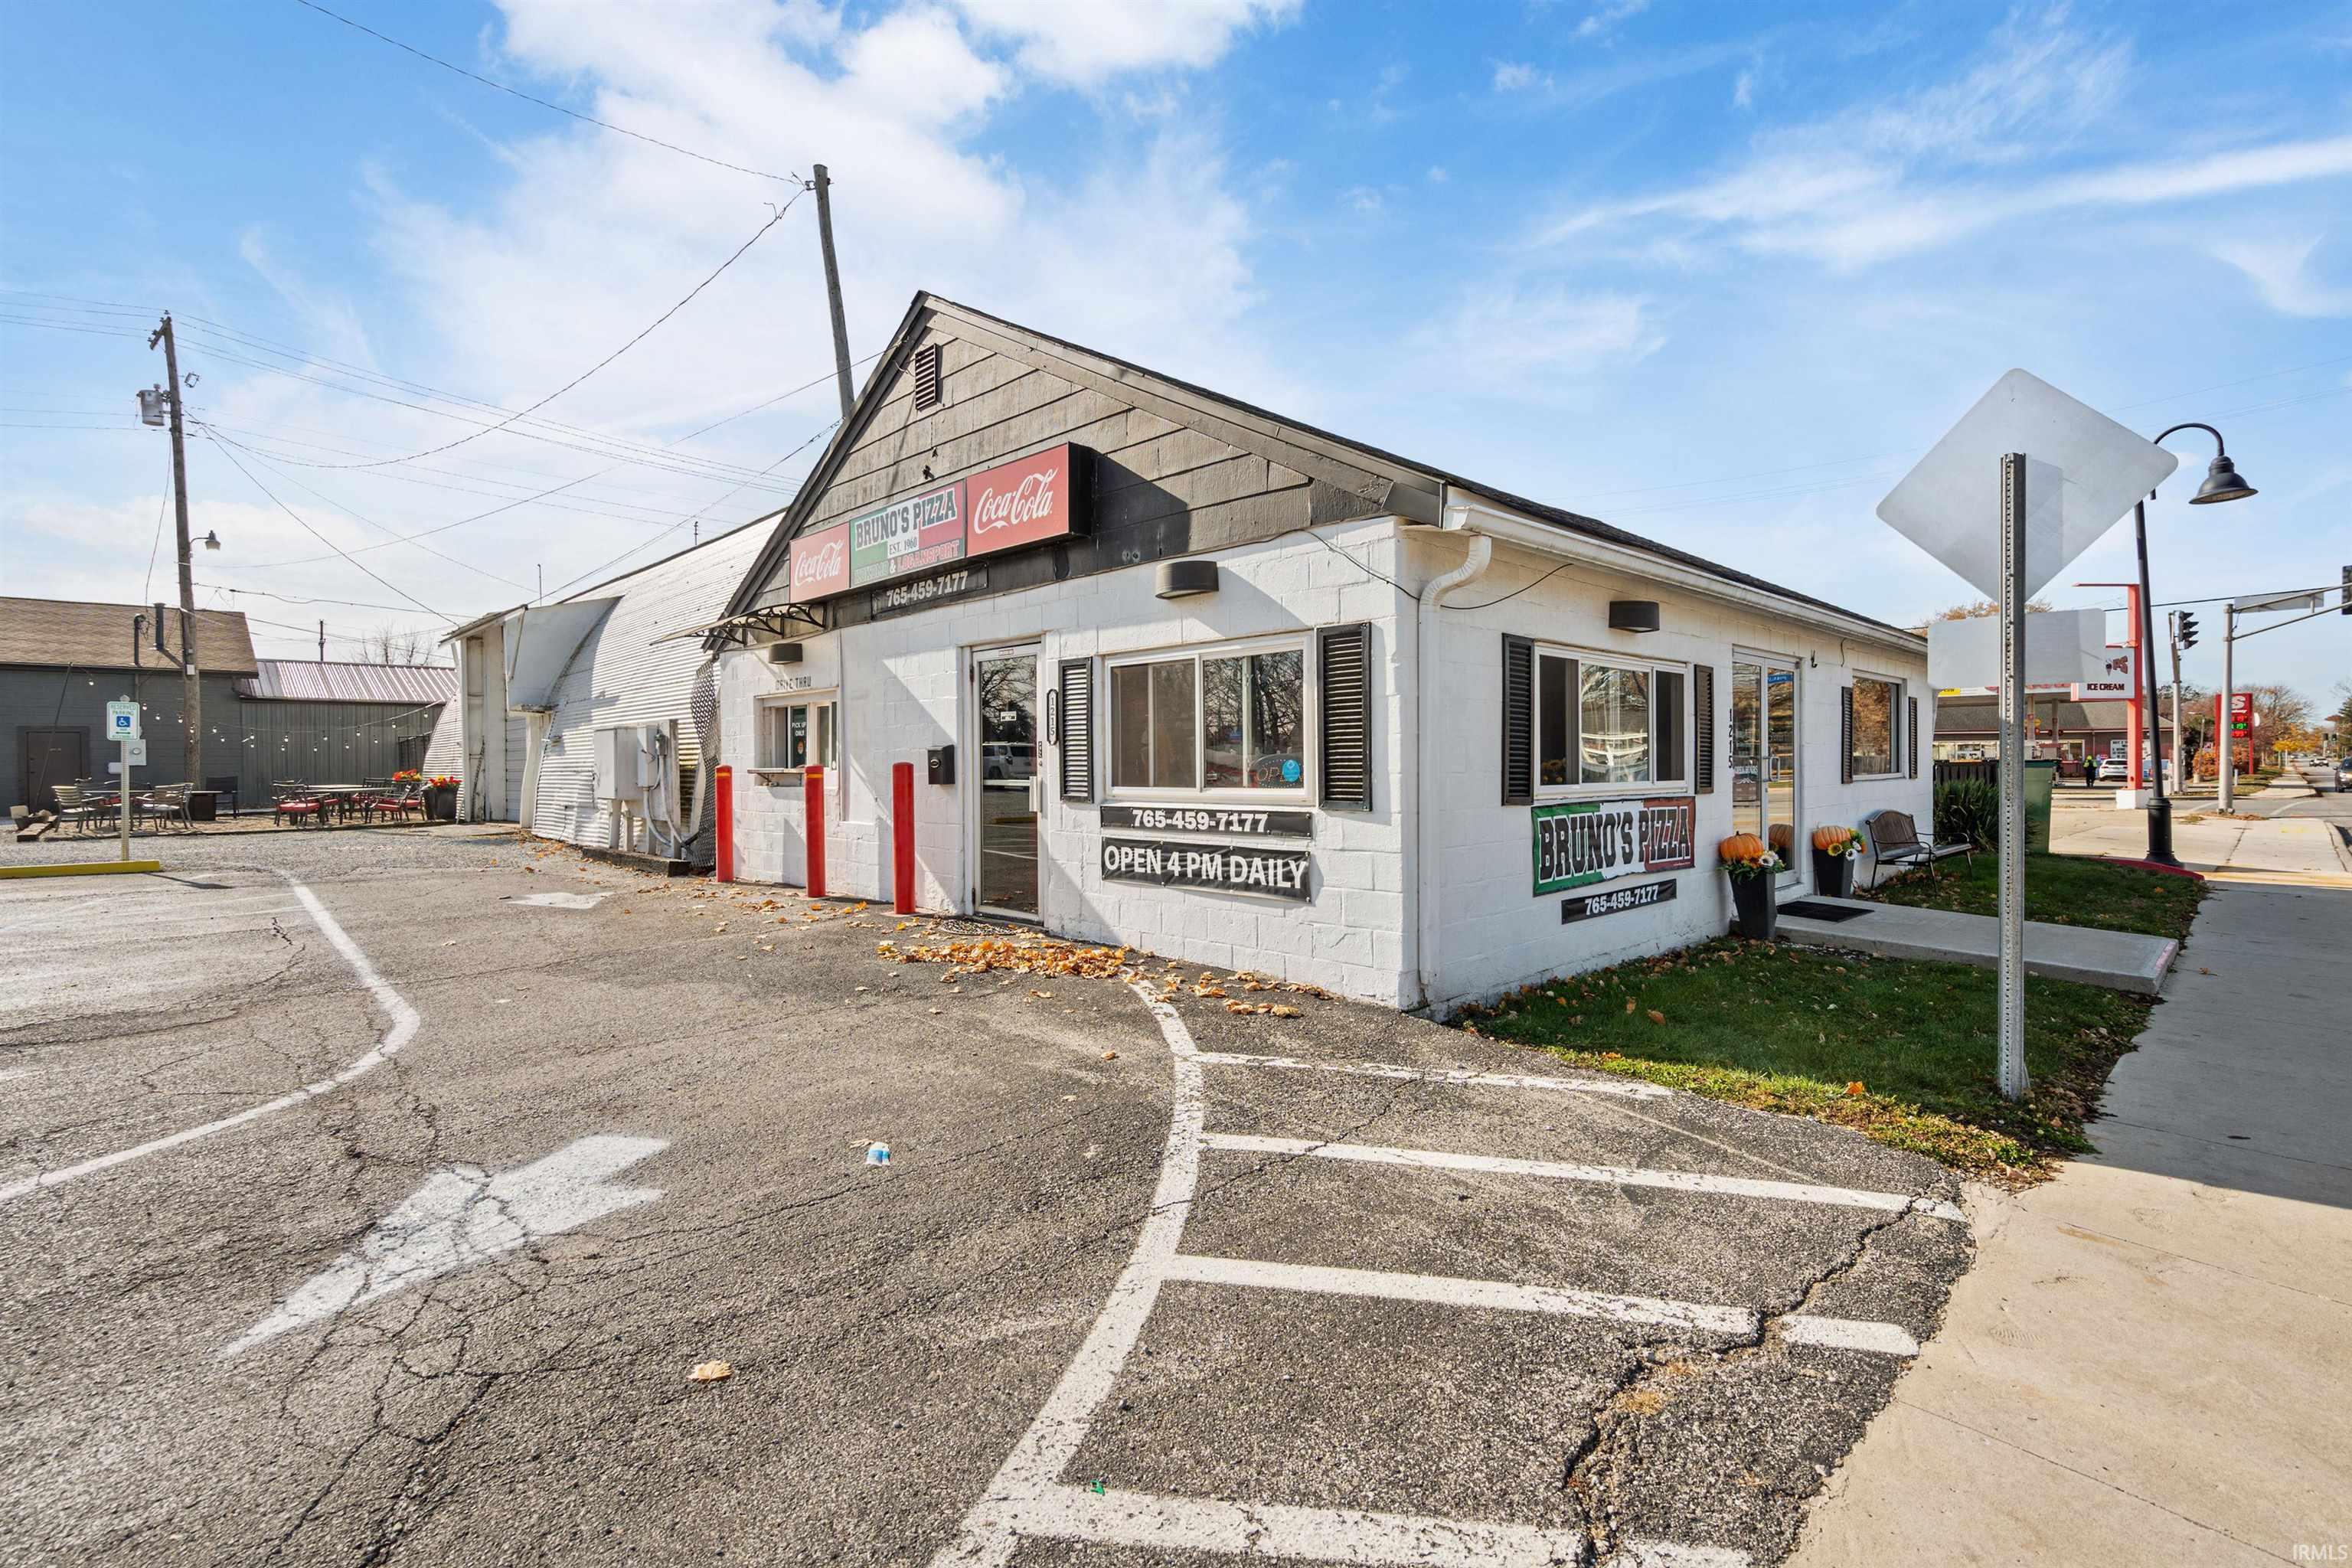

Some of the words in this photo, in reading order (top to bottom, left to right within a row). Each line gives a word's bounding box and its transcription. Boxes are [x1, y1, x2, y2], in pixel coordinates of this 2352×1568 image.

[855, 506, 910, 548] BRUNO'S
[913, 488, 957, 530] PIZZA
[974, 467, 1059, 534] Coca-Cola
[795, 539, 843, 586] Coca-Cola
[889, 541, 902, 555] EST.
[904, 537, 918, 551] 1960
[890, 559, 897, 574] &
[887, 570, 969, 608] 765-459-7177
[795, 676, 811, 688] THRU
[1132, 809, 1268, 834] 765-459-7177
[1539, 811, 1634, 882] BRUNO'S
[1638, 805, 1690, 864] PIZZA
[1104, 845, 1161, 875] OPEN
[1167, 851, 1181, 877] 4
[1186, 851, 1222, 880] PM
[1230, 855, 1307, 889] DAILY
[1584, 885, 1659, 916] 765-459-7177
